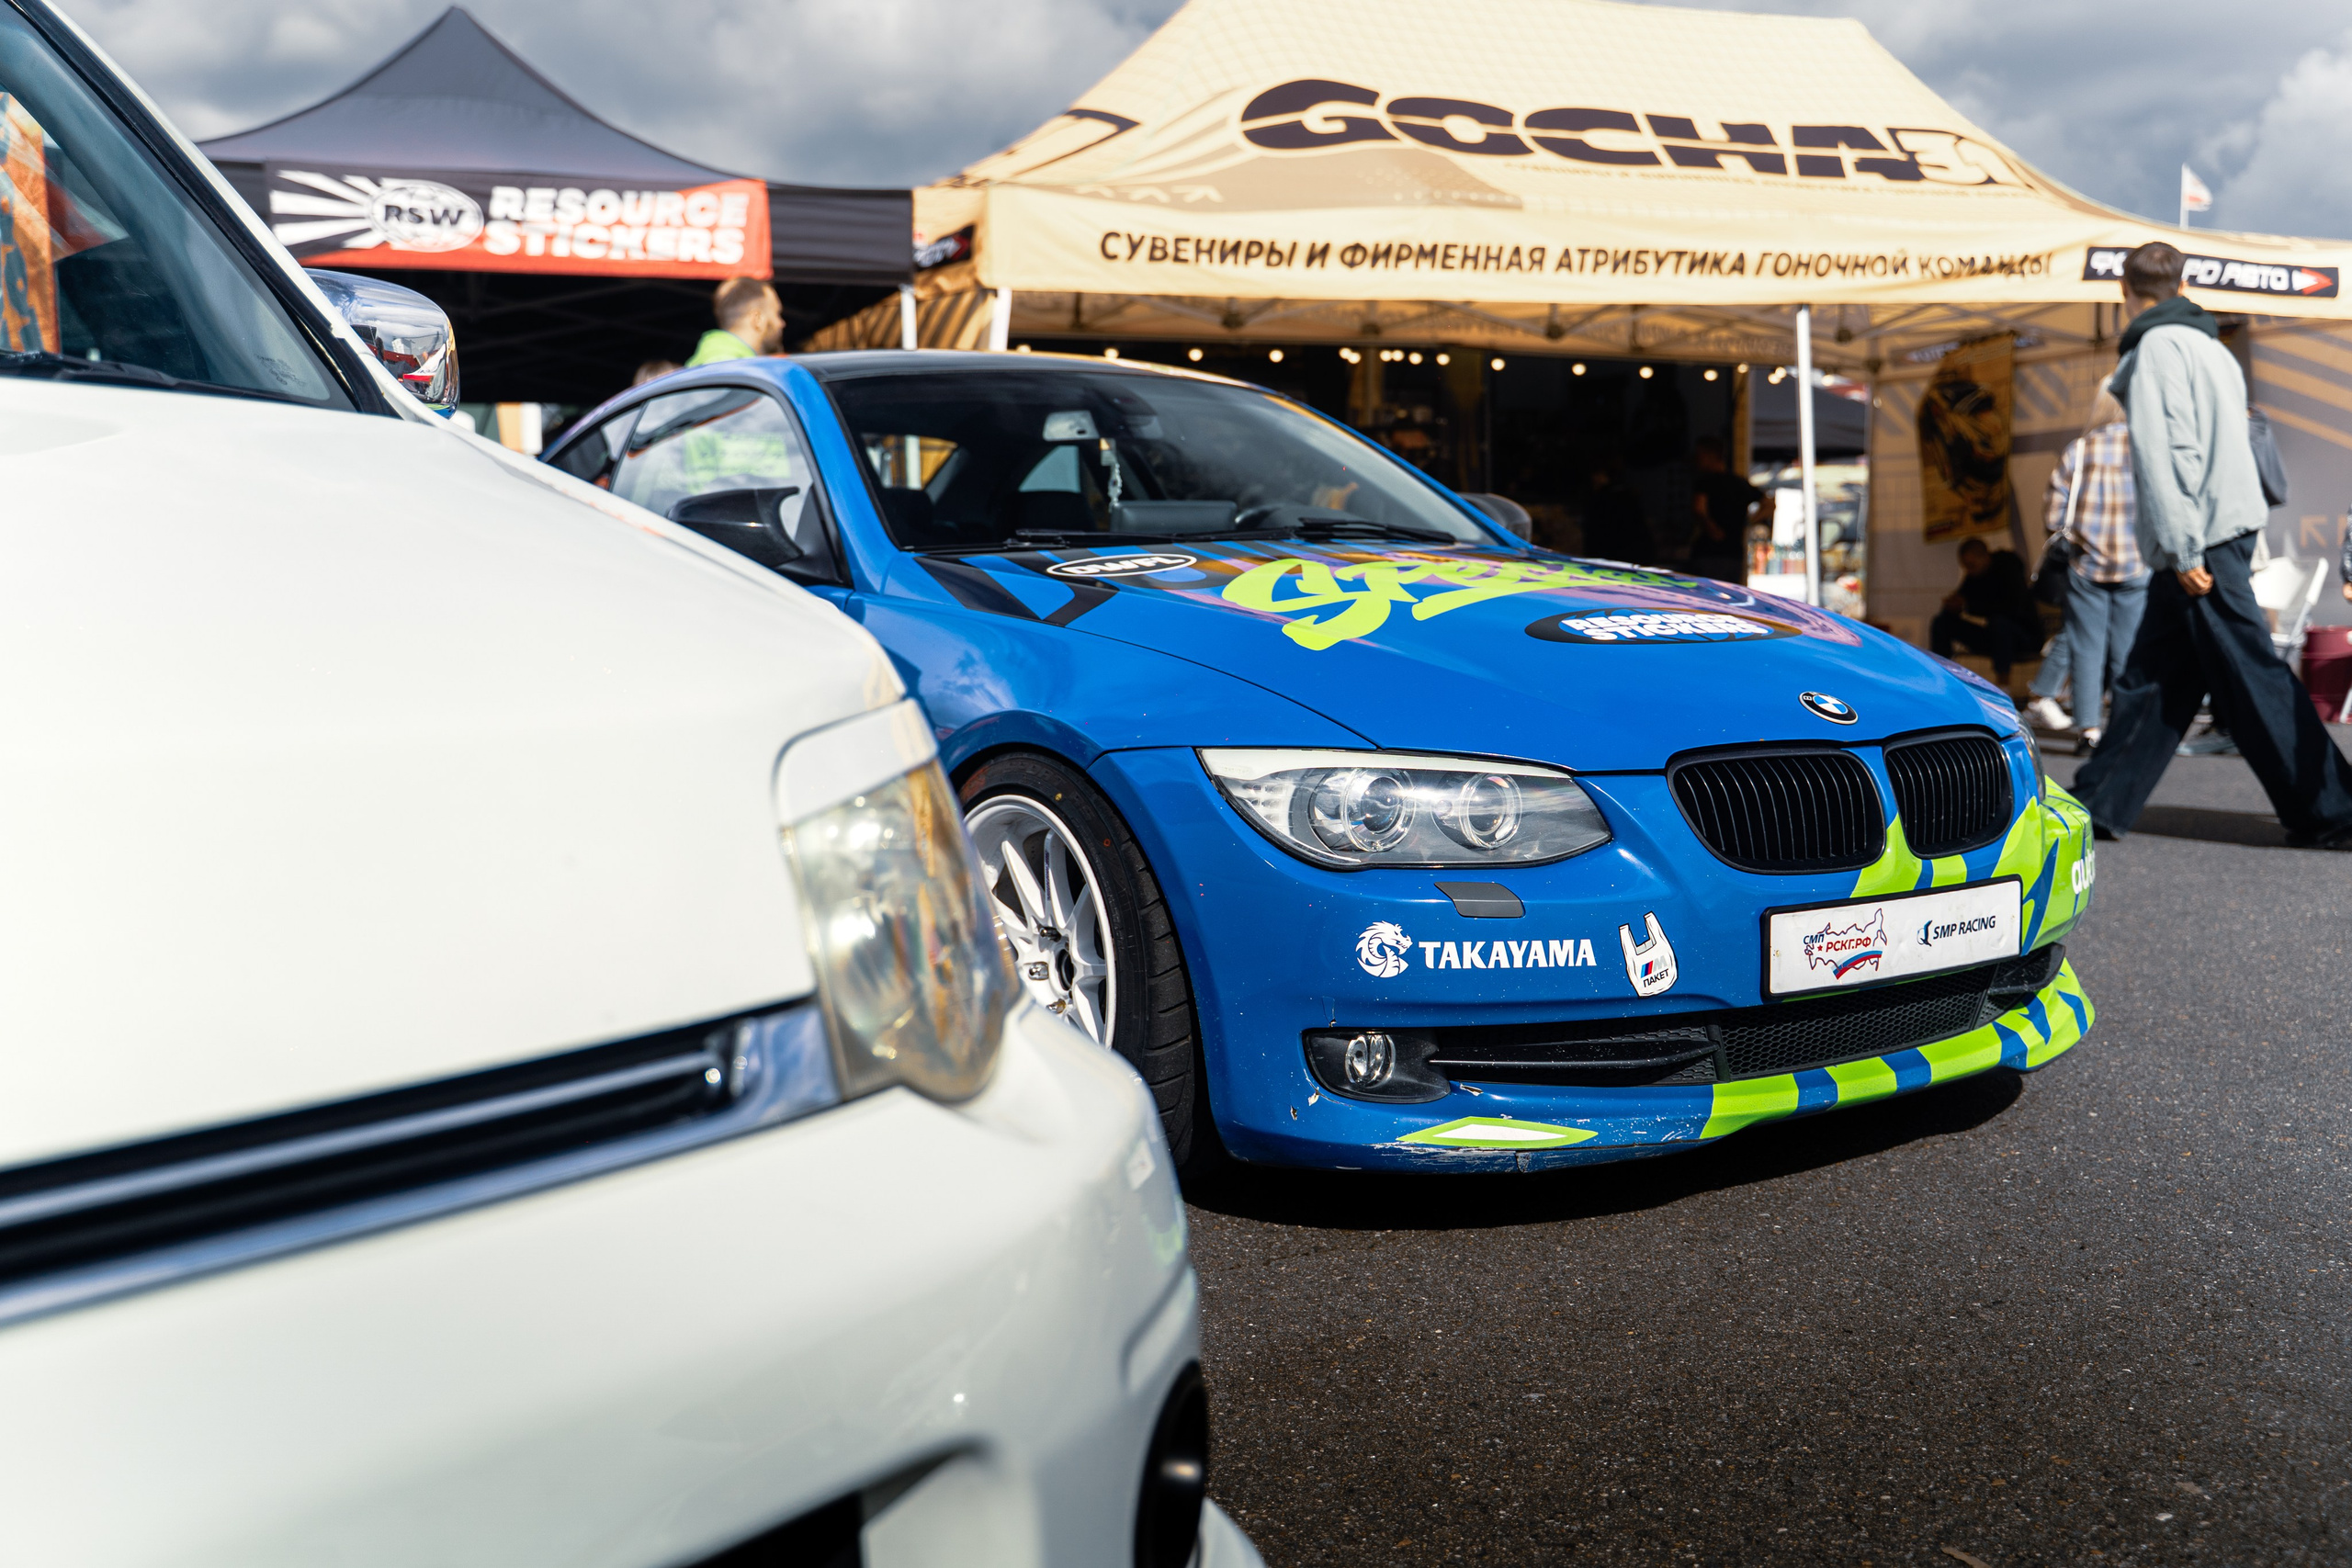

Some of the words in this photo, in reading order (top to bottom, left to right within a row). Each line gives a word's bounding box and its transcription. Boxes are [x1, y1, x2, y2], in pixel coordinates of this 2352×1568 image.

[383, 203, 464, 226] RSW
[487, 186, 751, 228] RESOURCE
[482, 221, 746, 265] STICKERS
[1100, 231, 1296, 268] СУВЕНИРЫ
[1306, 242, 1330, 268] И
[1340, 242, 1547, 273] ФИРМЕННАЯ
[1555, 247, 1747, 276] АТРИБУТИКА
[1756, 248, 1909, 278] ГОНОЧНОЙ
[1561, 614, 1740, 631] RESOURCE
[1583, 622, 1769, 641] STICKERS
[1803, 933, 1825, 945] СМП
[1933, 923, 1957, 940] SMP
[1958, 915, 1996, 935] RACING
[1419, 939, 1597, 969] TAKAYAMA
[1826, 936, 1871, 953] РСКГ.РФ
[1643, 968, 1669, 987] ПАКЕТ
